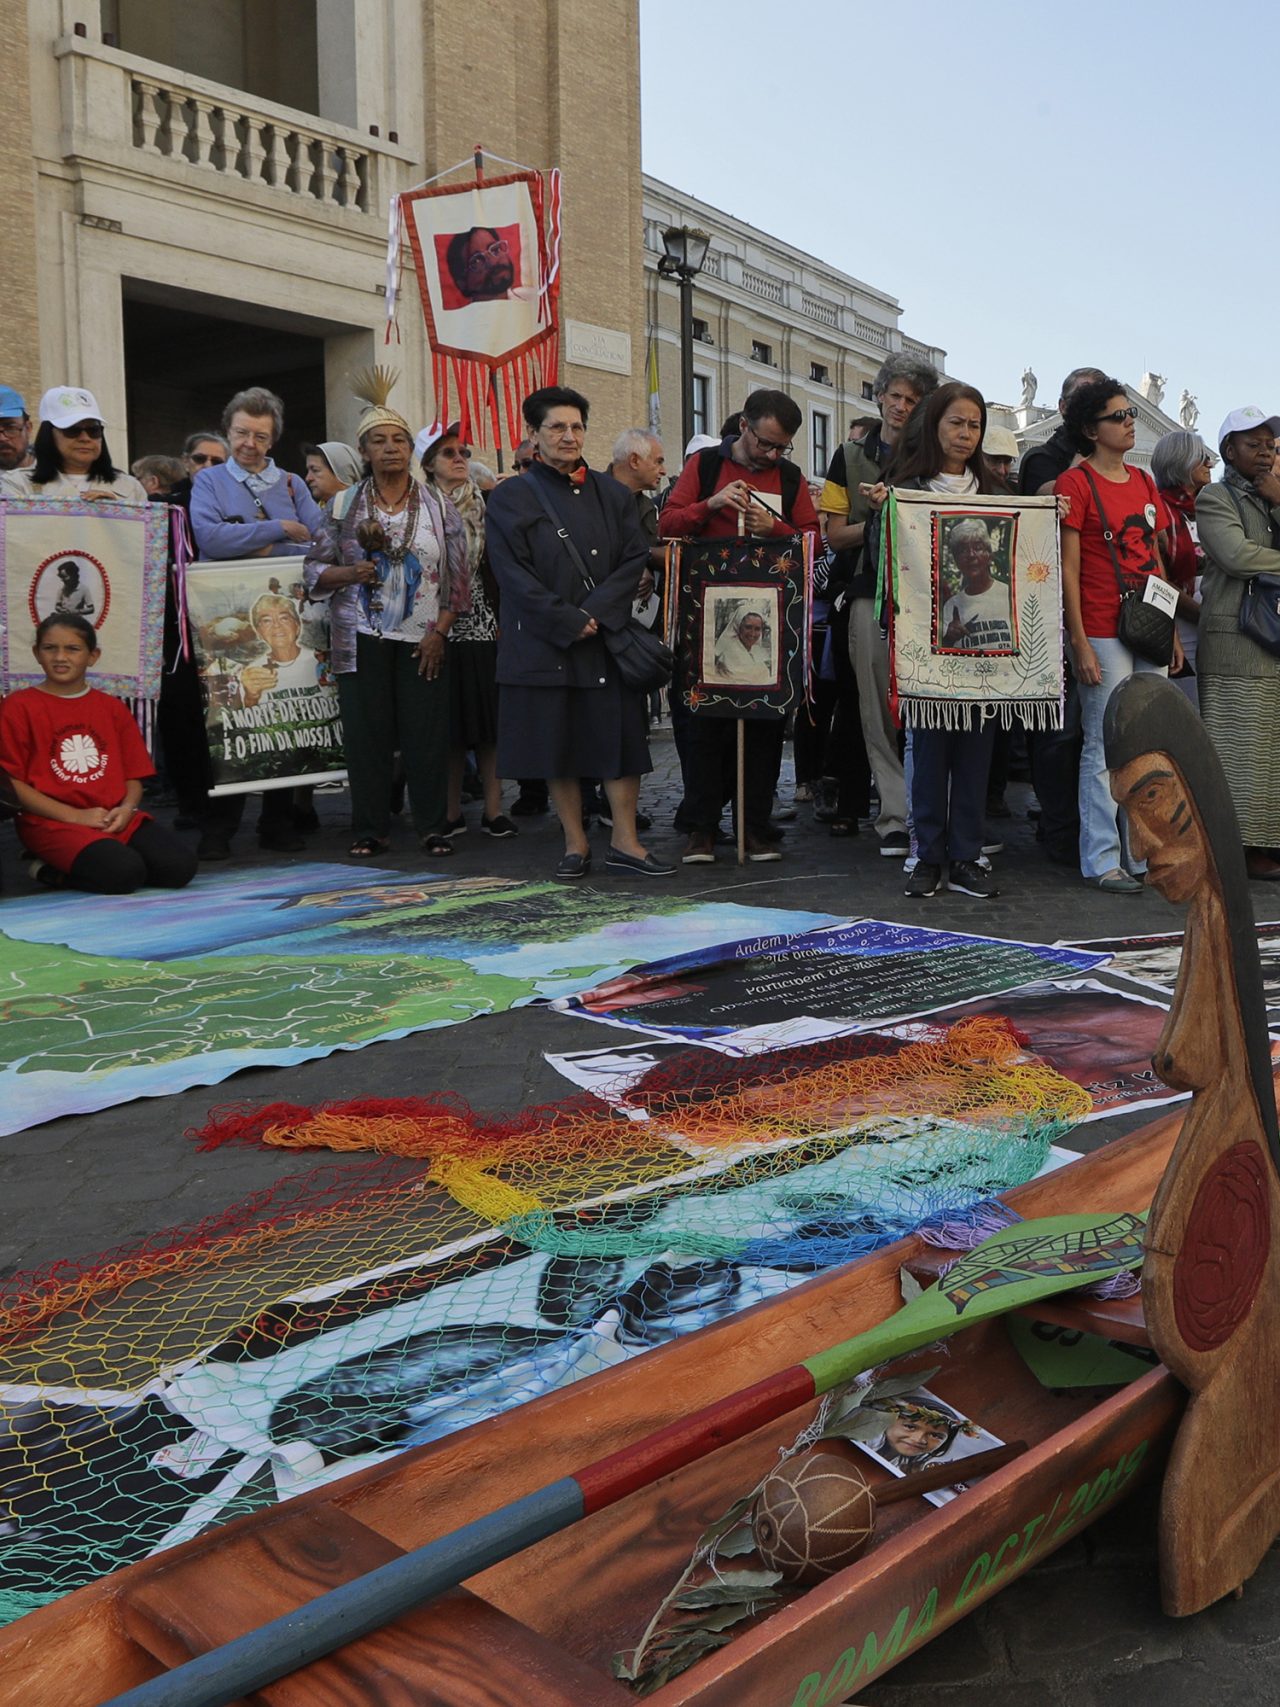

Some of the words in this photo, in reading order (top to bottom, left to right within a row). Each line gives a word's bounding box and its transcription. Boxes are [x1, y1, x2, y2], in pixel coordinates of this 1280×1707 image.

[222, 711, 233, 731] A
[232, 702, 278, 728] MORTE
[280, 701, 299, 722] DA
[235, 735, 247, 759] O
[248, 732, 275, 754] FIM
[275, 731, 293, 751] DA
[293, 726, 332, 748] NOSSA
[50, 759, 71, 782] caring
[73, 775, 88, 784] for
[791, 1587, 938, 1707] ROMA
